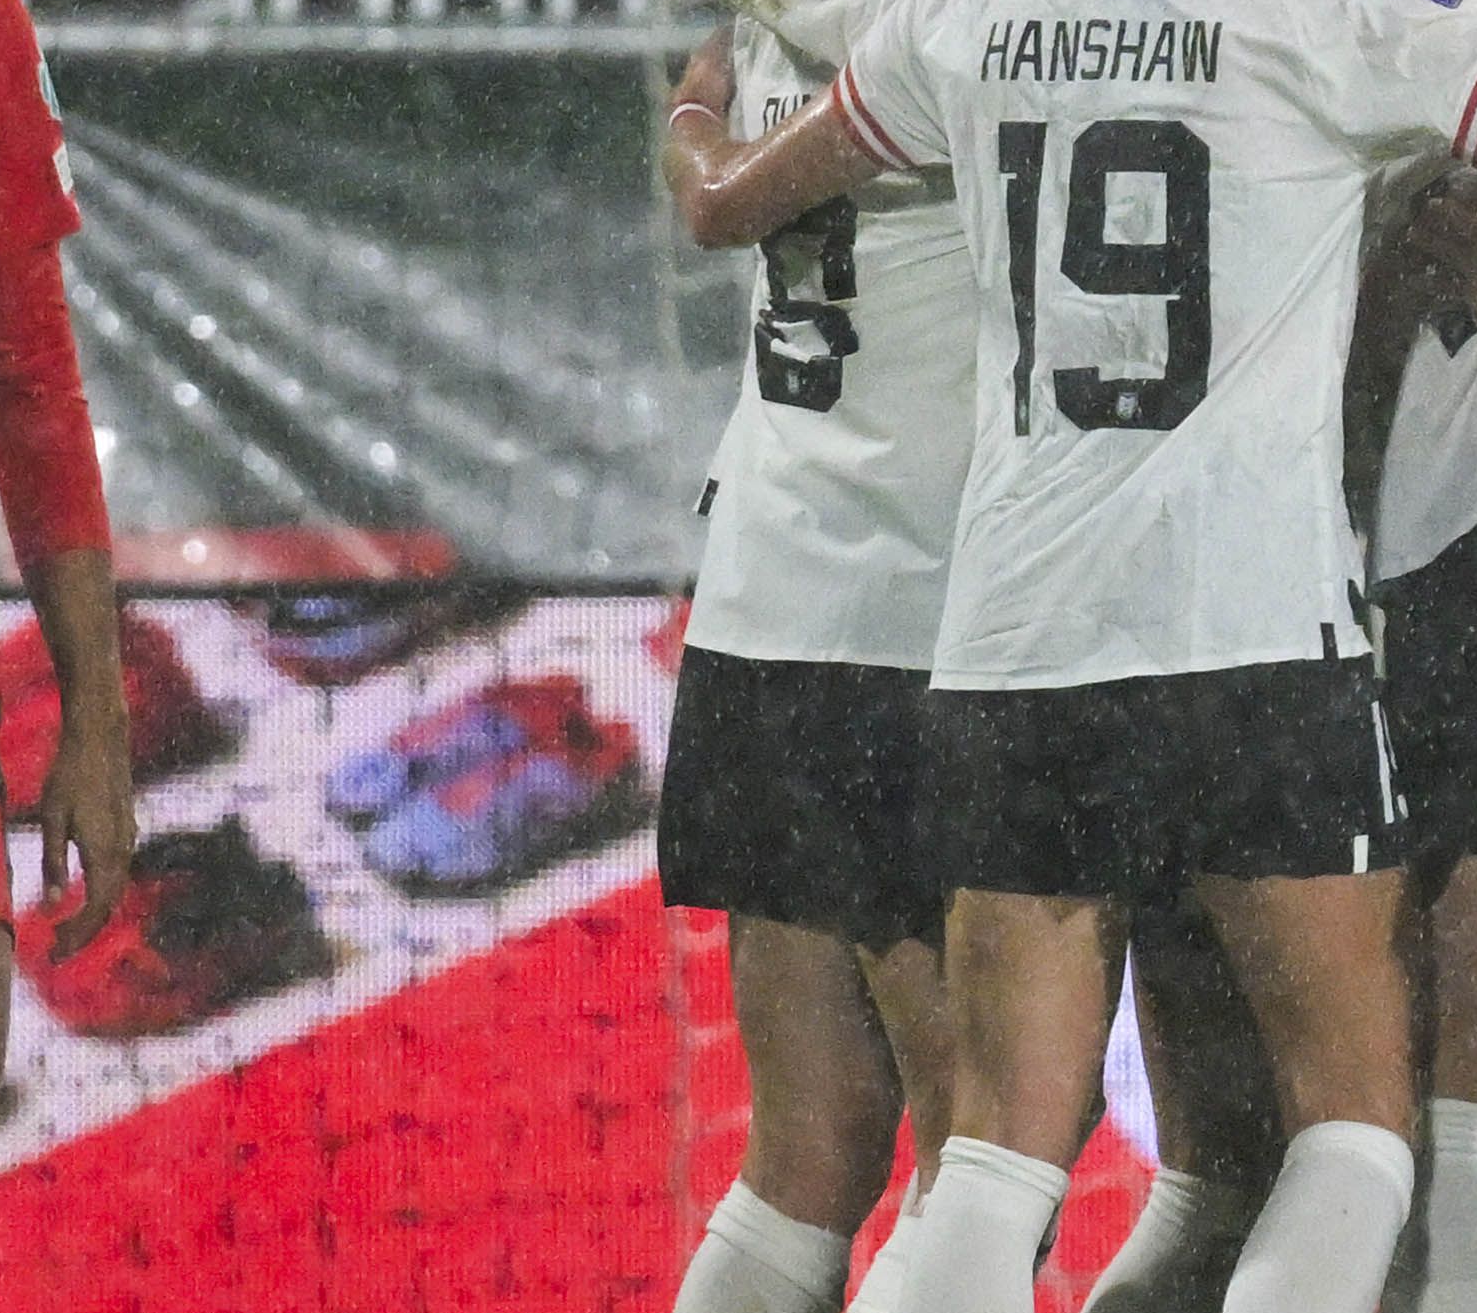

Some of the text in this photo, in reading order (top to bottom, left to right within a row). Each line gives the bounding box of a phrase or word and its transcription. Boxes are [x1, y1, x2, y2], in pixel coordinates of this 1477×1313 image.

[981, 19, 1223, 82] HANSHAW
[755, 194, 859, 413] 8
[998, 120, 1212, 436] 19
